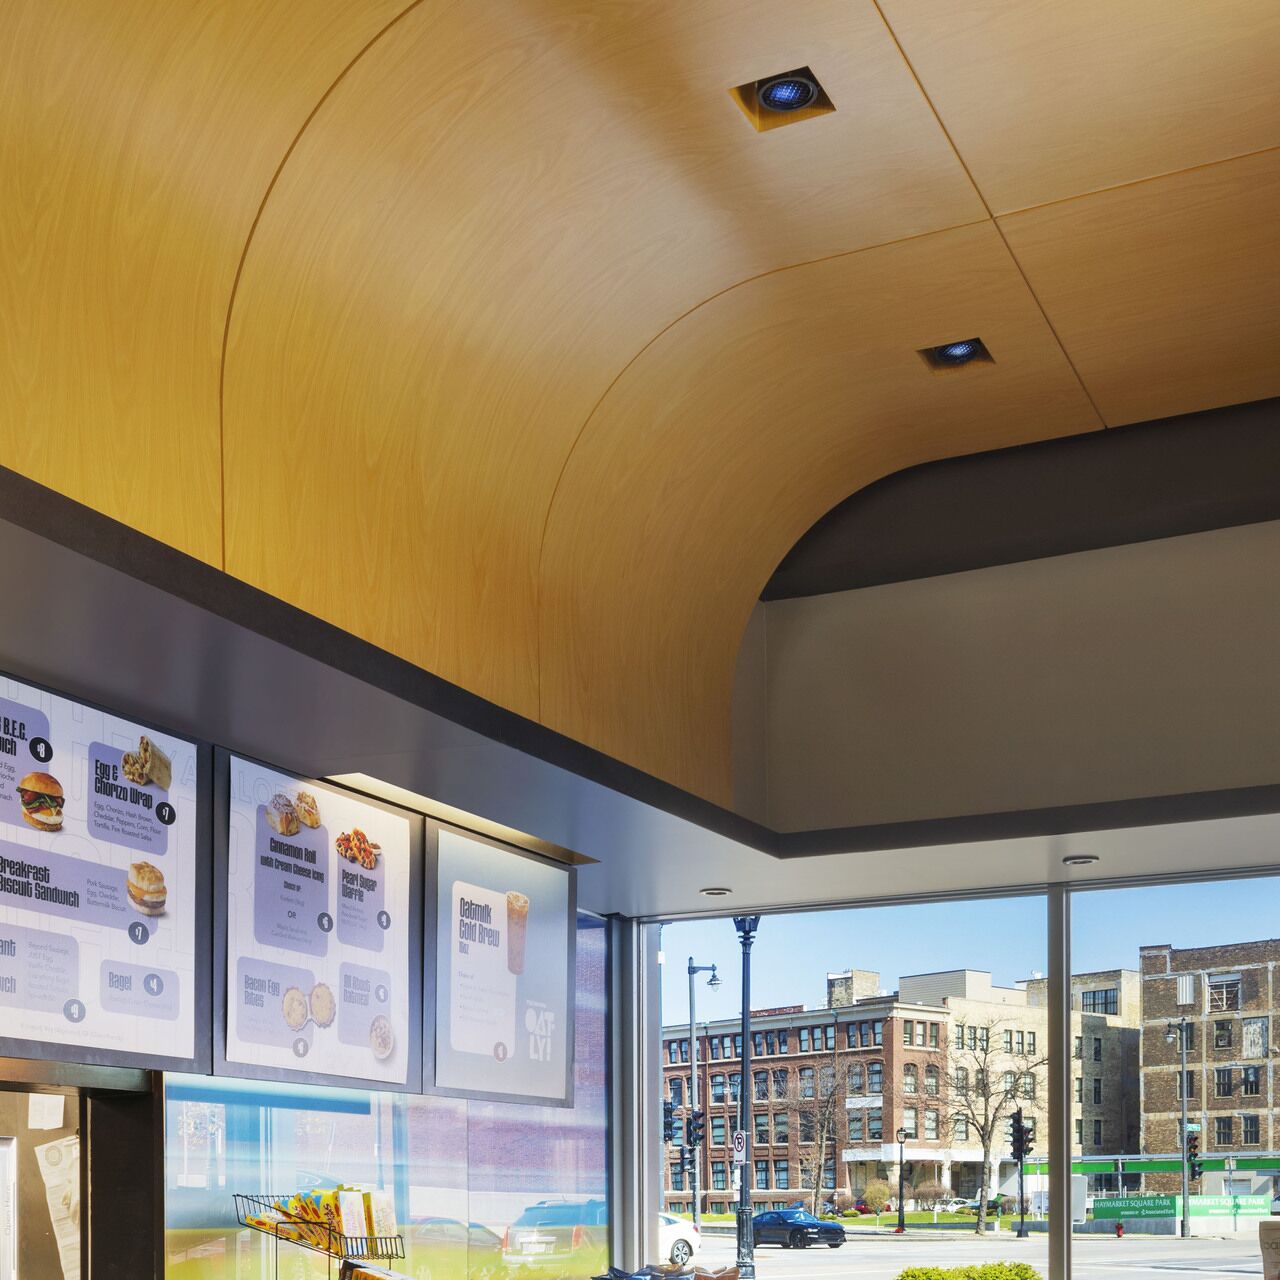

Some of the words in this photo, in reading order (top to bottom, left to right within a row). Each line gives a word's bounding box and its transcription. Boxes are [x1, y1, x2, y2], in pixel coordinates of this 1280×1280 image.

[3, 717, 28, 741] B.E.C.
[95, 759, 111, 780] Egg
[112, 765, 118, 781] &
[95, 776, 128, 802] Chorizo
[130, 787, 153, 810] Wrap
[270, 837, 303, 860] Cinnamon
[304, 847, 317, 865] Roll
[260, 855, 273, 868] with
[274, 859, 292, 874] Cream
[293, 863, 311, 878] Cheese
[342, 869, 358, 886] Pearl
[359, 875, 377, 892] Sugar
[35, 882, 80, 909] Sandwich
[341, 885, 364, 902] Waffle
[459, 897, 492, 925] Oatmilk
[459, 919, 477, 941] Cold
[478, 924, 500, 948] Brew
[109, 972, 132, 991] Bagel
[244, 975, 266, 993] Bacon
[268, 979, 280, 997] Egg
[1094, 1200, 1129, 1208] HAYMARKET
[1130, 1199, 1154, 1208] SQUARE
[1155, 1198, 1171, 1206] PARK
[1178, 1198, 1219, 1206] HYMARKET
